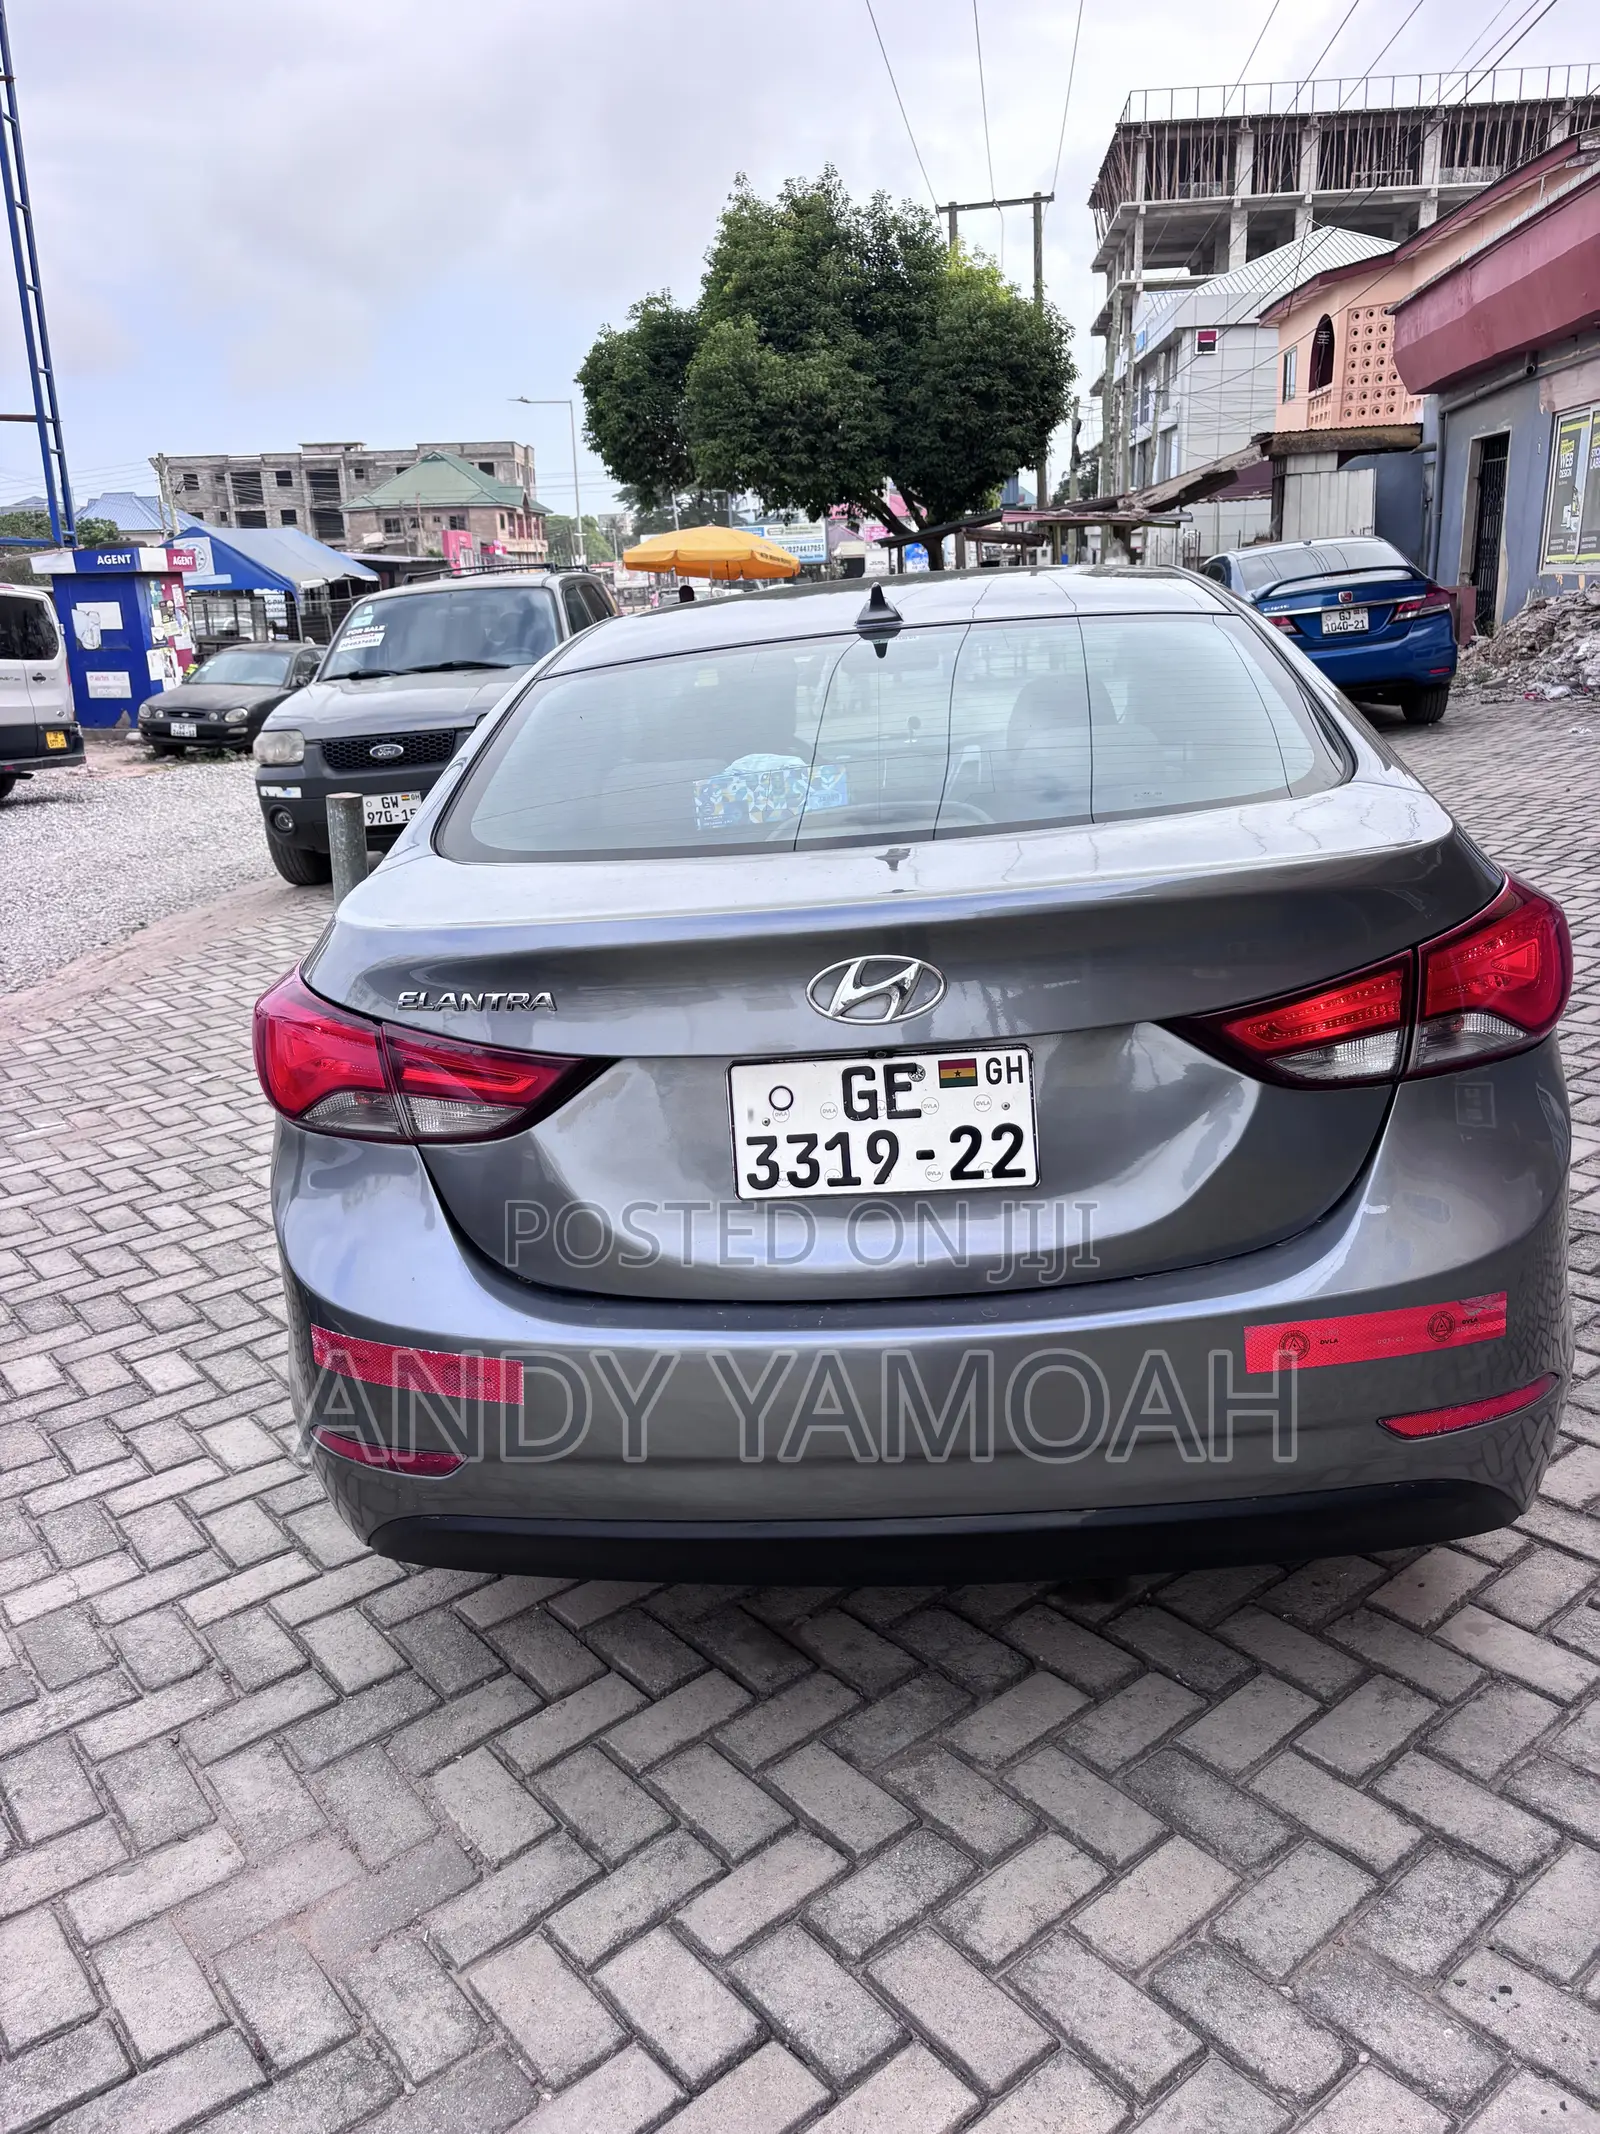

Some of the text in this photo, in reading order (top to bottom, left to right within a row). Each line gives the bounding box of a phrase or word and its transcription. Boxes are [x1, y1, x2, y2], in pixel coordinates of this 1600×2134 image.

[1560, 452, 1574, 468] WEB
[97, 554, 131, 565] AGENT
[172, 556, 193, 566] AGENT
[1339, 611, 1351, 621] GJ
[346, 625, 385, 636] FOR SALE
[1325, 619, 1366, 633] 1040-21
[377, 747, 396, 756] Ford
[381, 795, 399, 809] GW
[397, 991, 557, 1012] ELANTRA
[842, 1055, 1024, 1121] GE GH
[746, 1122, 1026, 1190] 3319-22
